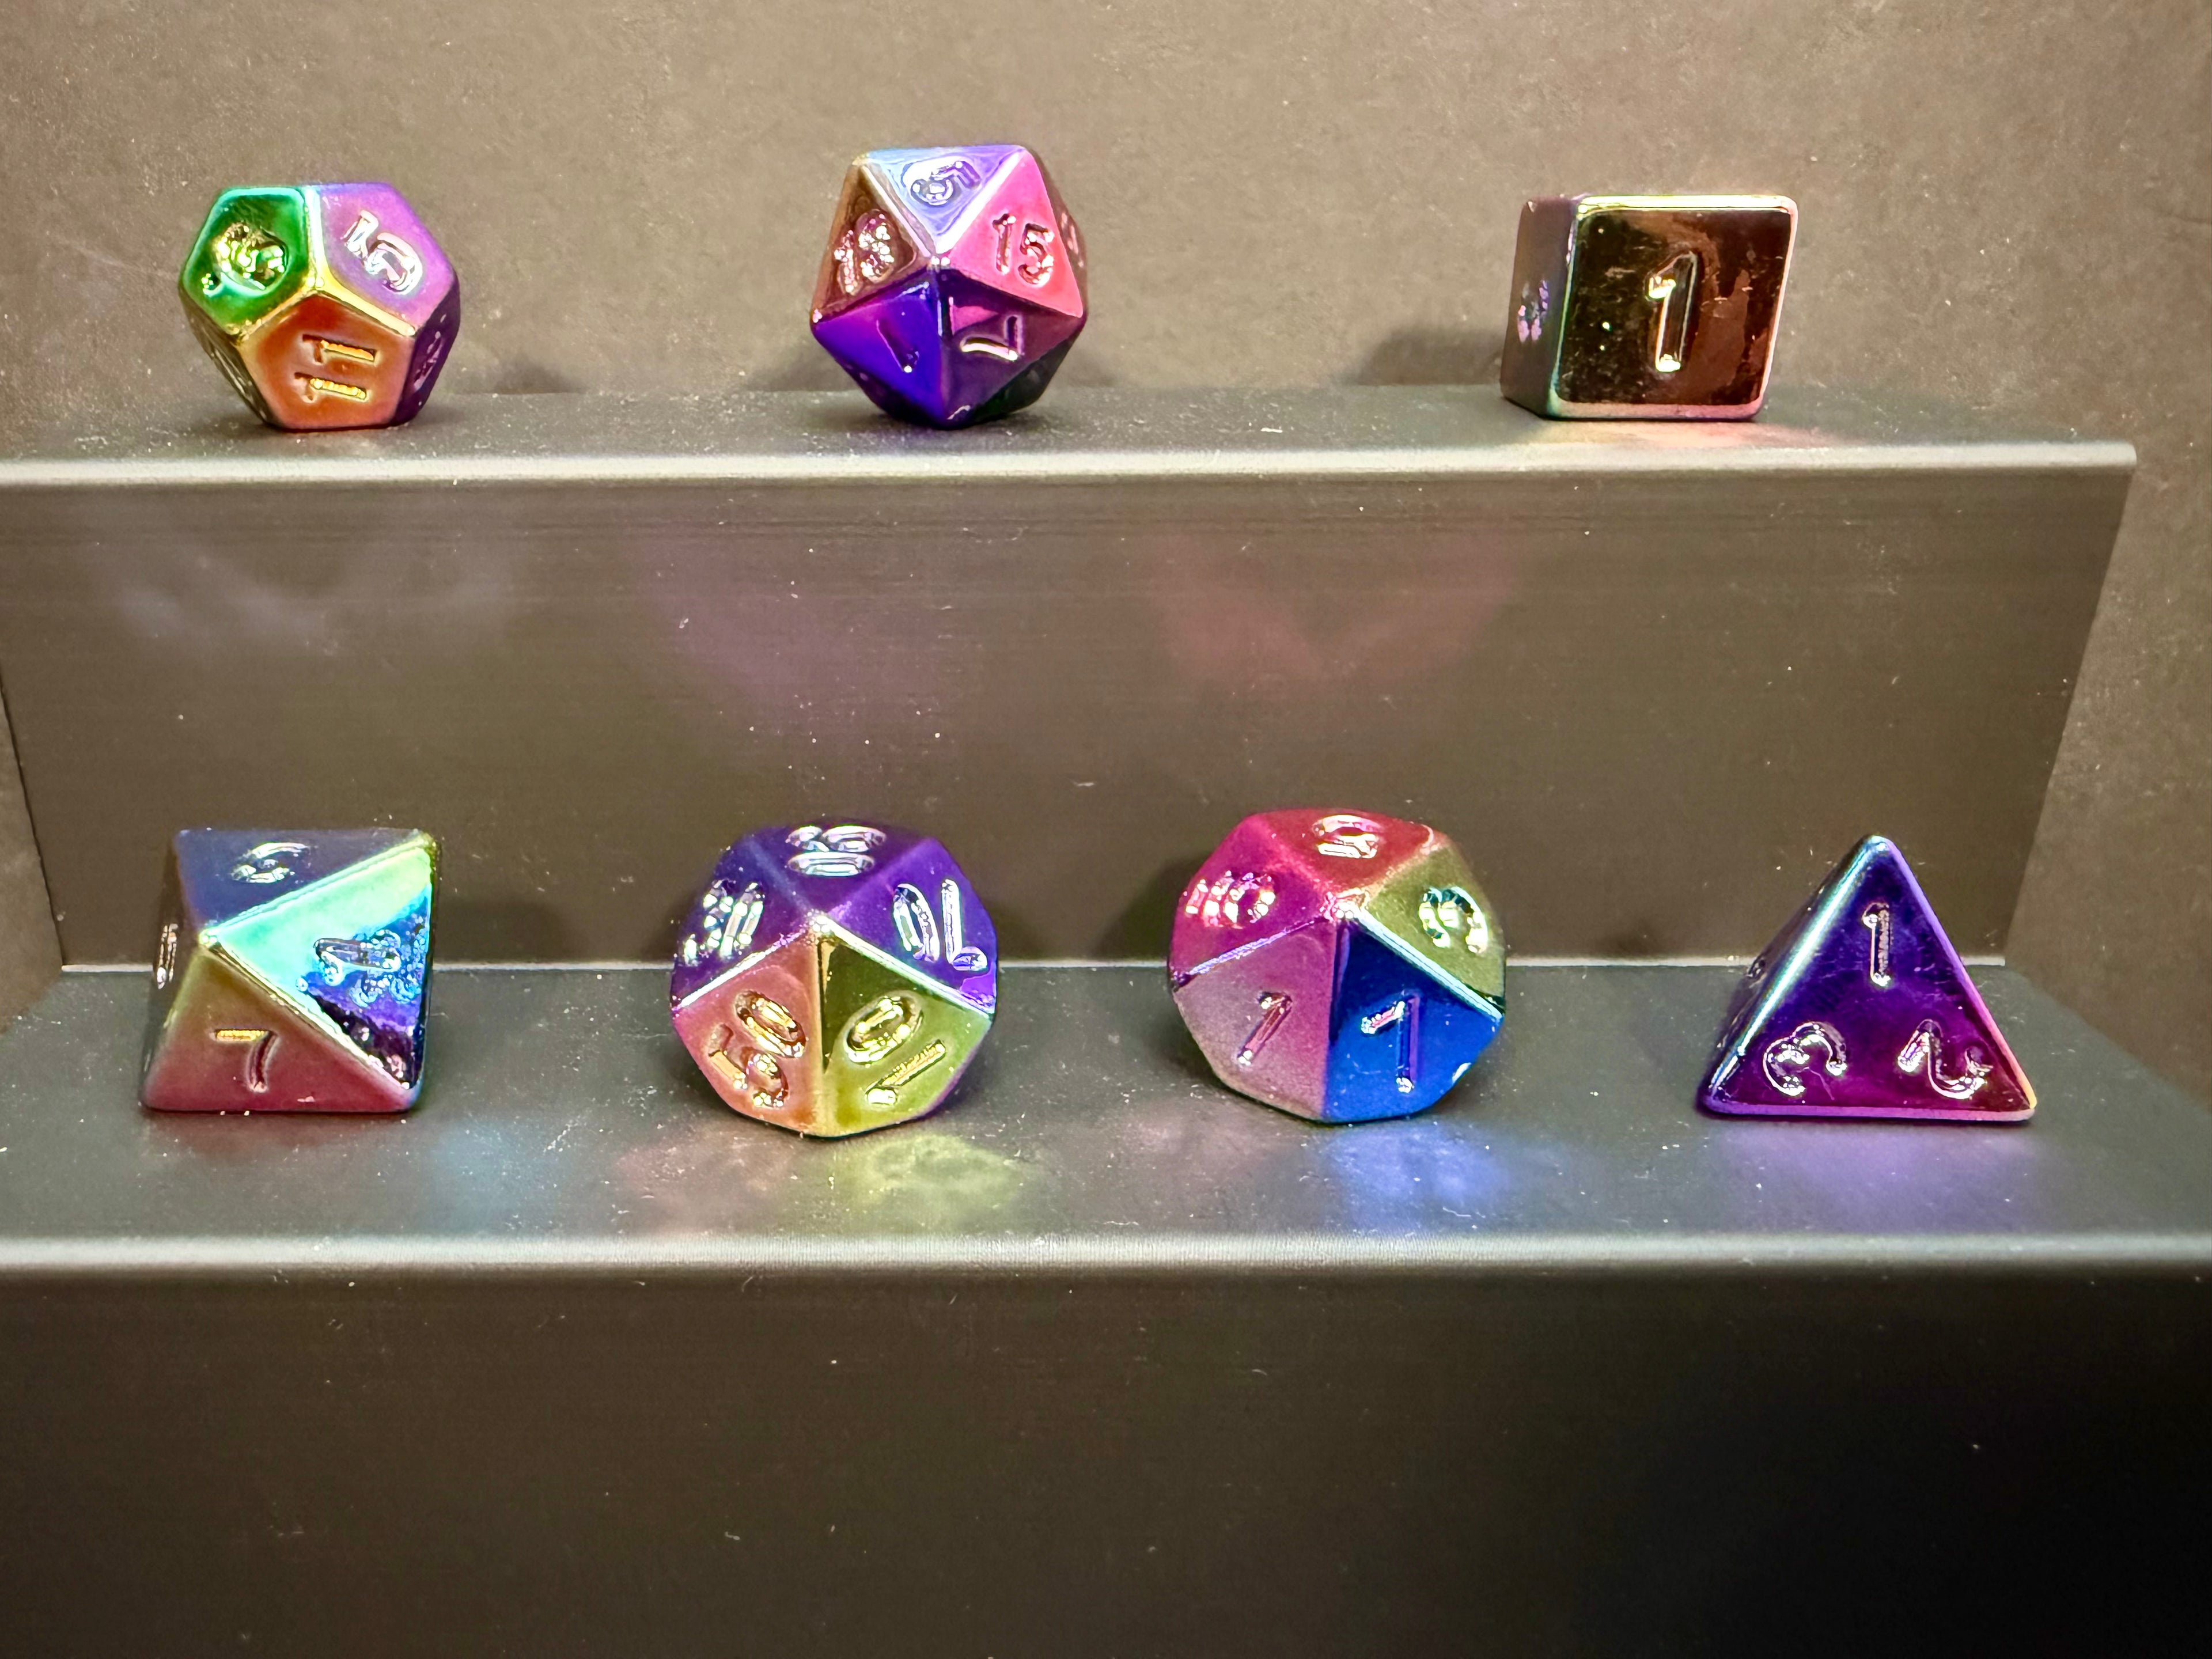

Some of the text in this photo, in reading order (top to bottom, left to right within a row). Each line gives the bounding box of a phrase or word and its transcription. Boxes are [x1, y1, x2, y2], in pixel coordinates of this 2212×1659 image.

[903, 156, 981, 206] 5
[344, 209, 423, 296] 5
[992, 212, 1054, 287] 15
[1645, 251, 1698, 373] 1
[294, 334, 379, 402] 11
[892, 878, 989, 972] 70
[1862, 902, 1892, 986] 1
[213, 1028, 278, 1094] 7
[706, 988, 807, 1108] 50
[843, 994, 948, 1106] 10
[1762, 1021, 1847, 1097] 3
[1897, 1018, 1994, 1100] 2
